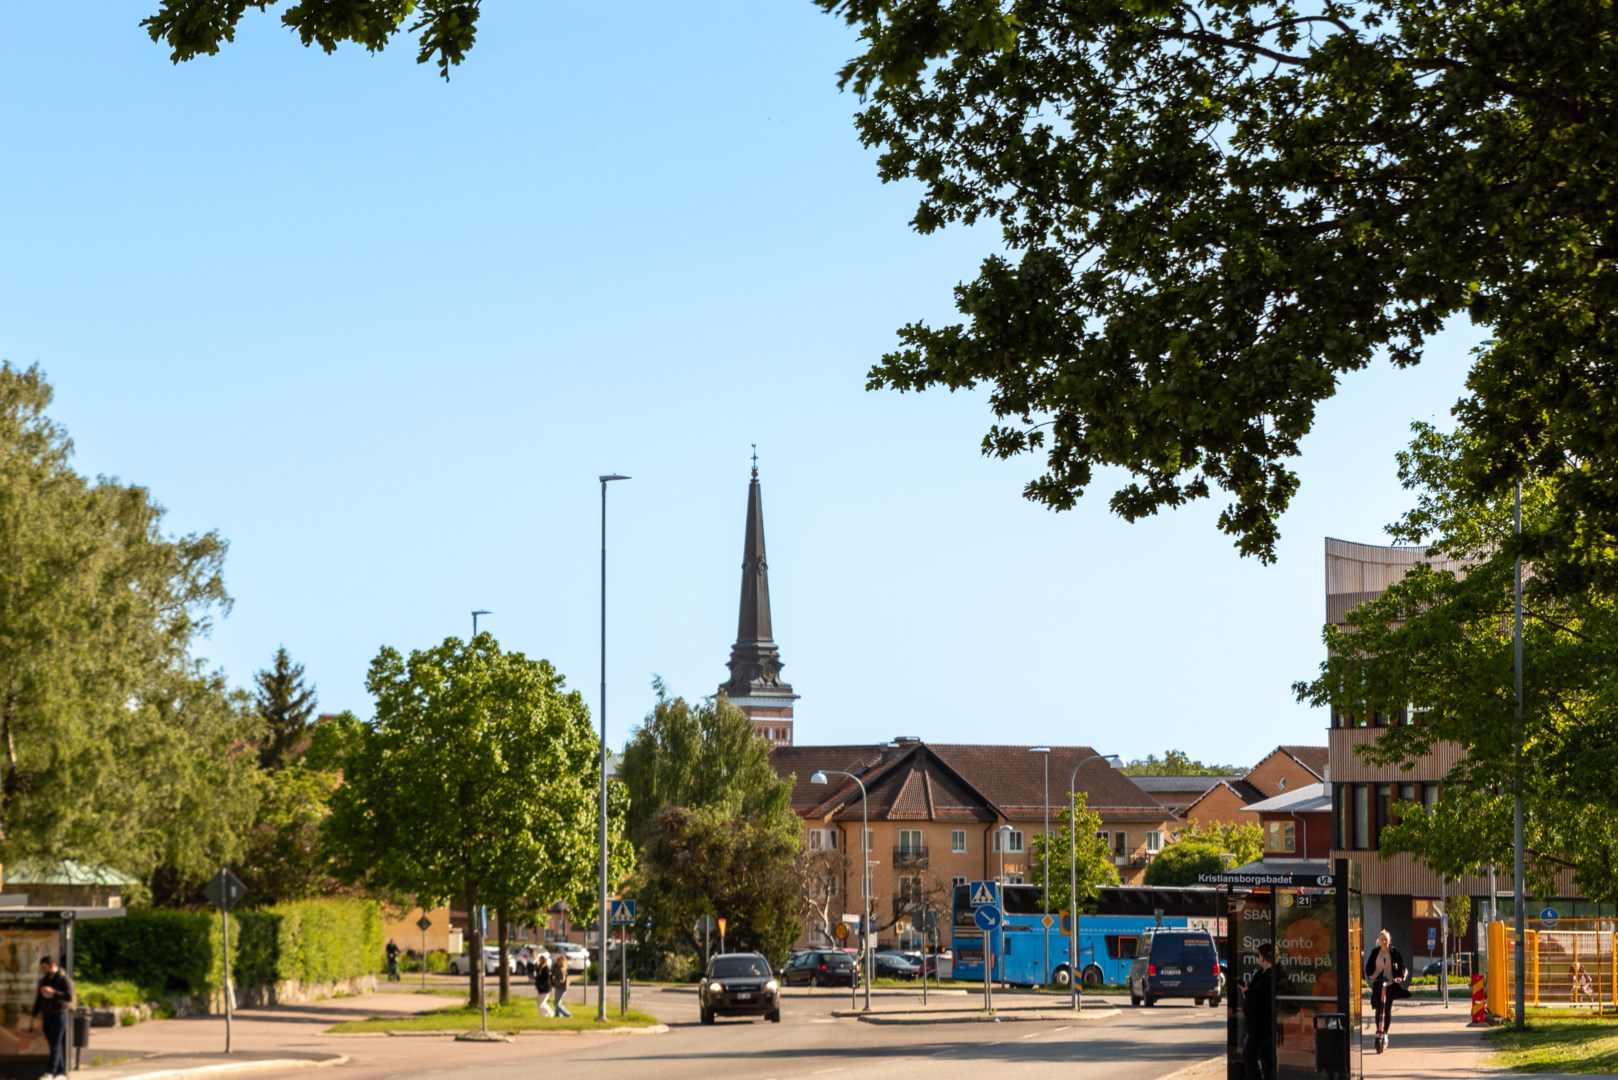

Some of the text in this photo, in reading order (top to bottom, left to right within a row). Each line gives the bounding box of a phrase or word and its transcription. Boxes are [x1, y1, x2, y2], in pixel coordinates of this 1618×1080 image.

[1198, 874, 1293, 885] Kristiansborgsbadet
[1319, 876, 1331, 885] VL
[1298, 896, 1309, 905] 21
[1243, 909, 1271, 920] SBA
[1315, 954, 1332, 968] på
